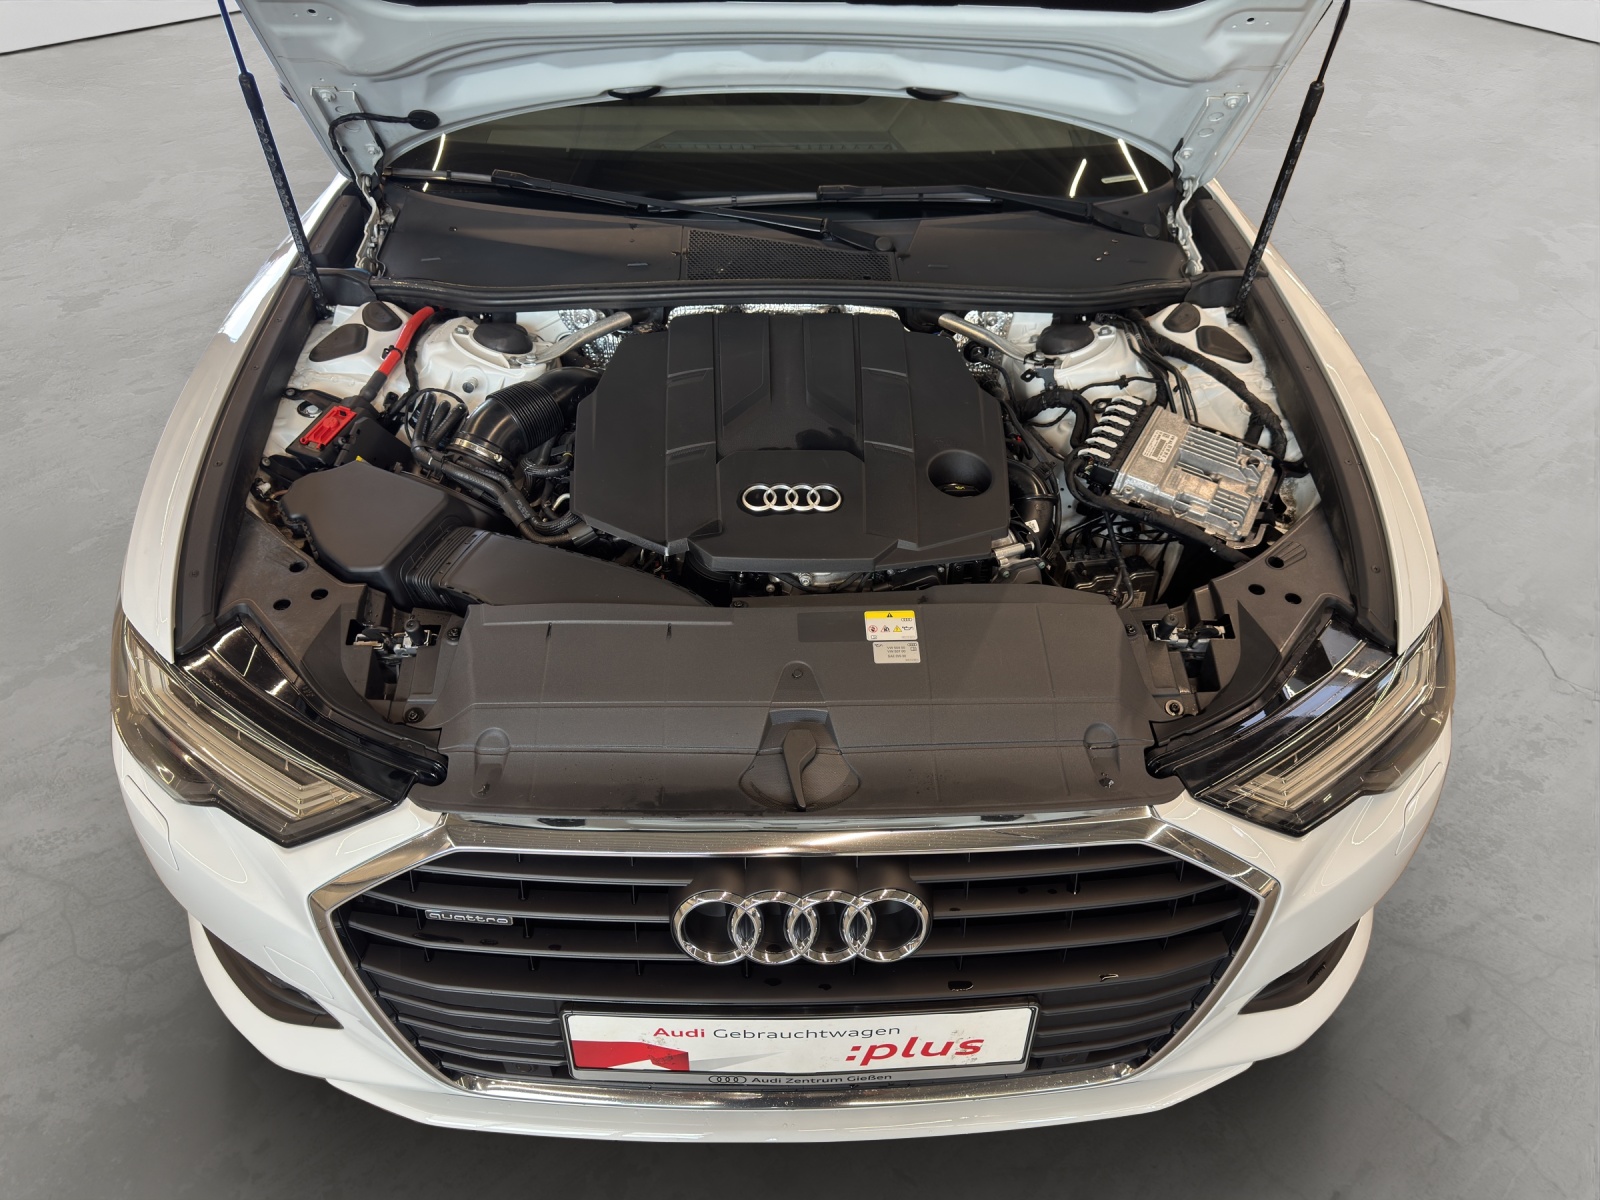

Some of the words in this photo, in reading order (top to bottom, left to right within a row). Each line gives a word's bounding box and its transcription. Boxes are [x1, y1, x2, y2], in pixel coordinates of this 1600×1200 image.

[429, 912, 508, 923] quattro
[653, 1027, 706, 1038] Audi
[713, 1027, 901, 1039] Gebrauchtwagen
[845, 1036, 985, 1067] :plus
[846, 1074, 892, 1082] Gießen
